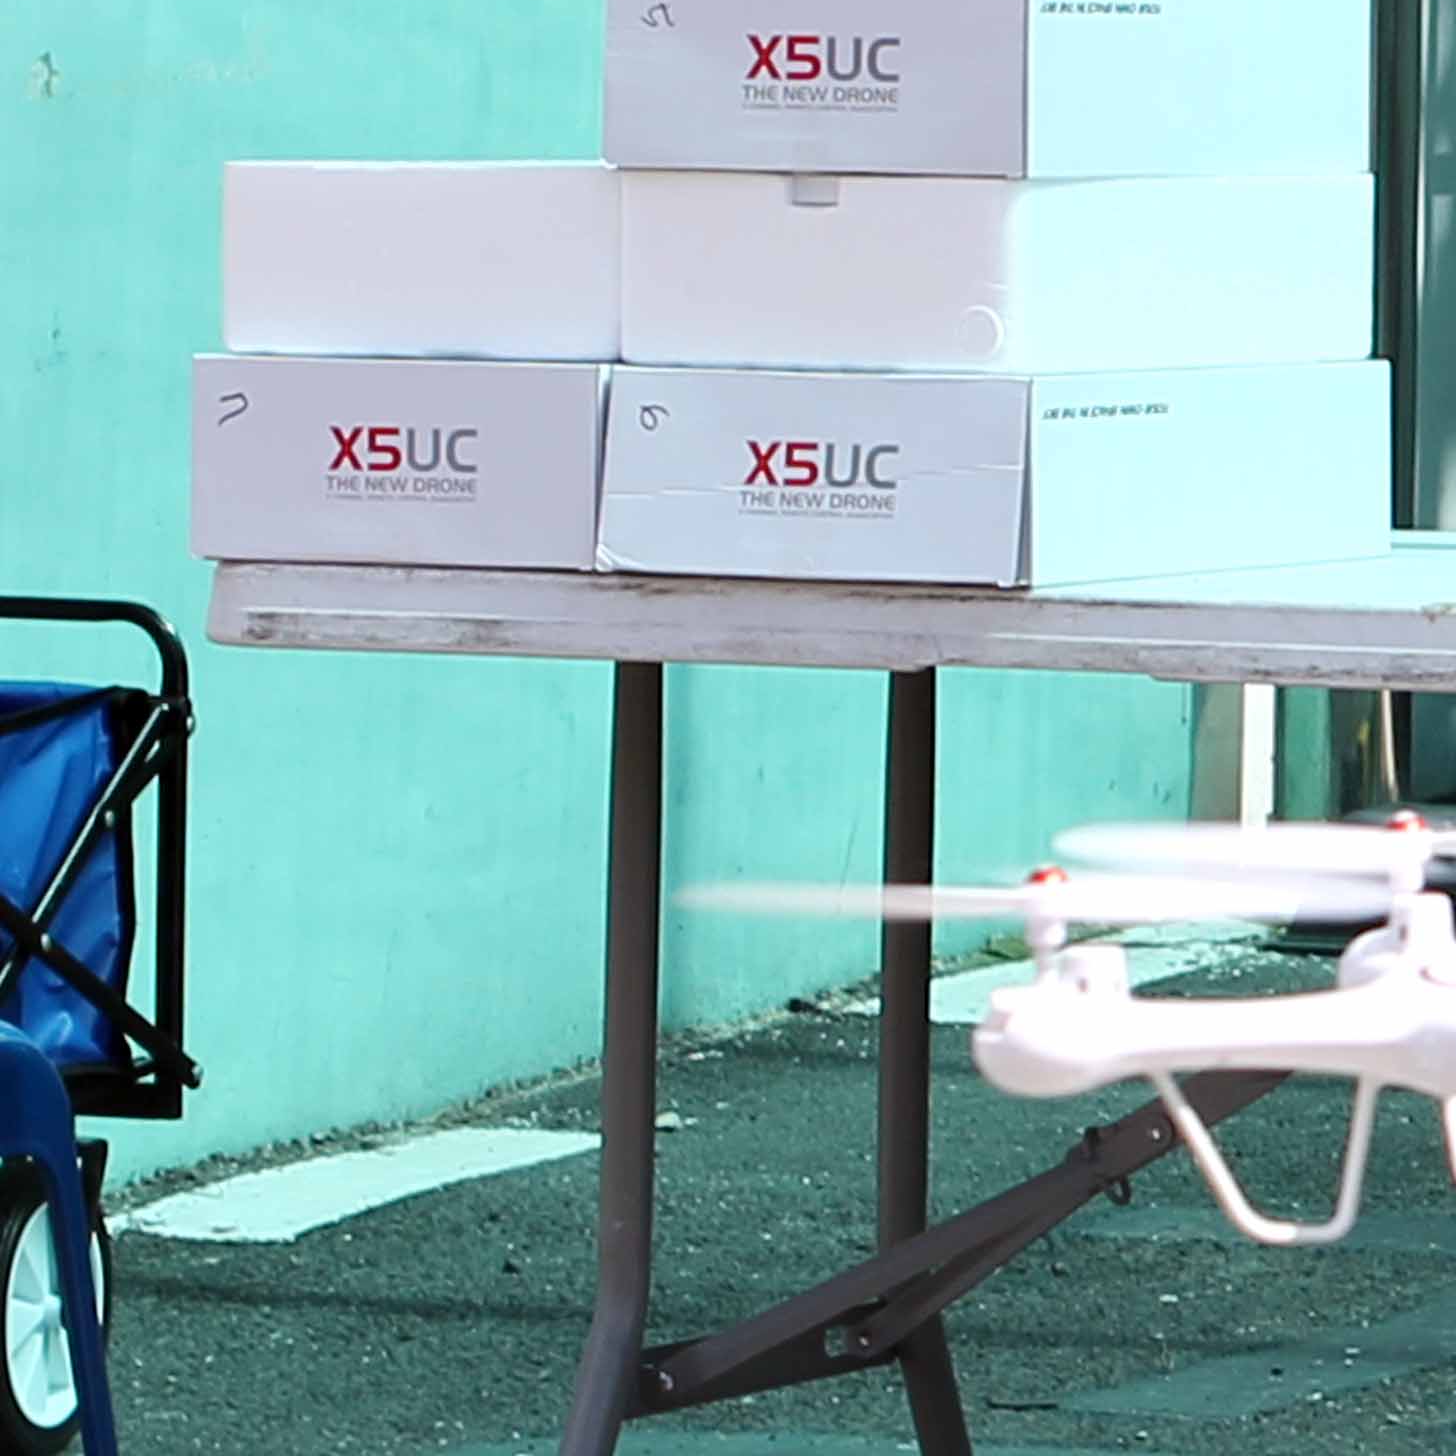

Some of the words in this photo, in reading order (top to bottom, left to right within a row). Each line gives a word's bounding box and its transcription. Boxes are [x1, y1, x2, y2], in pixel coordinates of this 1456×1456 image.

[745, 34, 902, 83] X5UC
[741, 85, 779, 101] THE
[783, 86, 829, 103] NEW
[833, 87, 899, 105] DRONE
[329, 426, 479, 474] X5UC
[744, 440, 901, 489] X5UC
[325, 475, 360, 492] THE
[364, 476, 409, 493] NEW
[413, 477, 478, 494] DRONE
[739, 490, 776, 507] THE
[779, 491, 826, 509] NEW
[829, 493, 896, 511] DRONE
